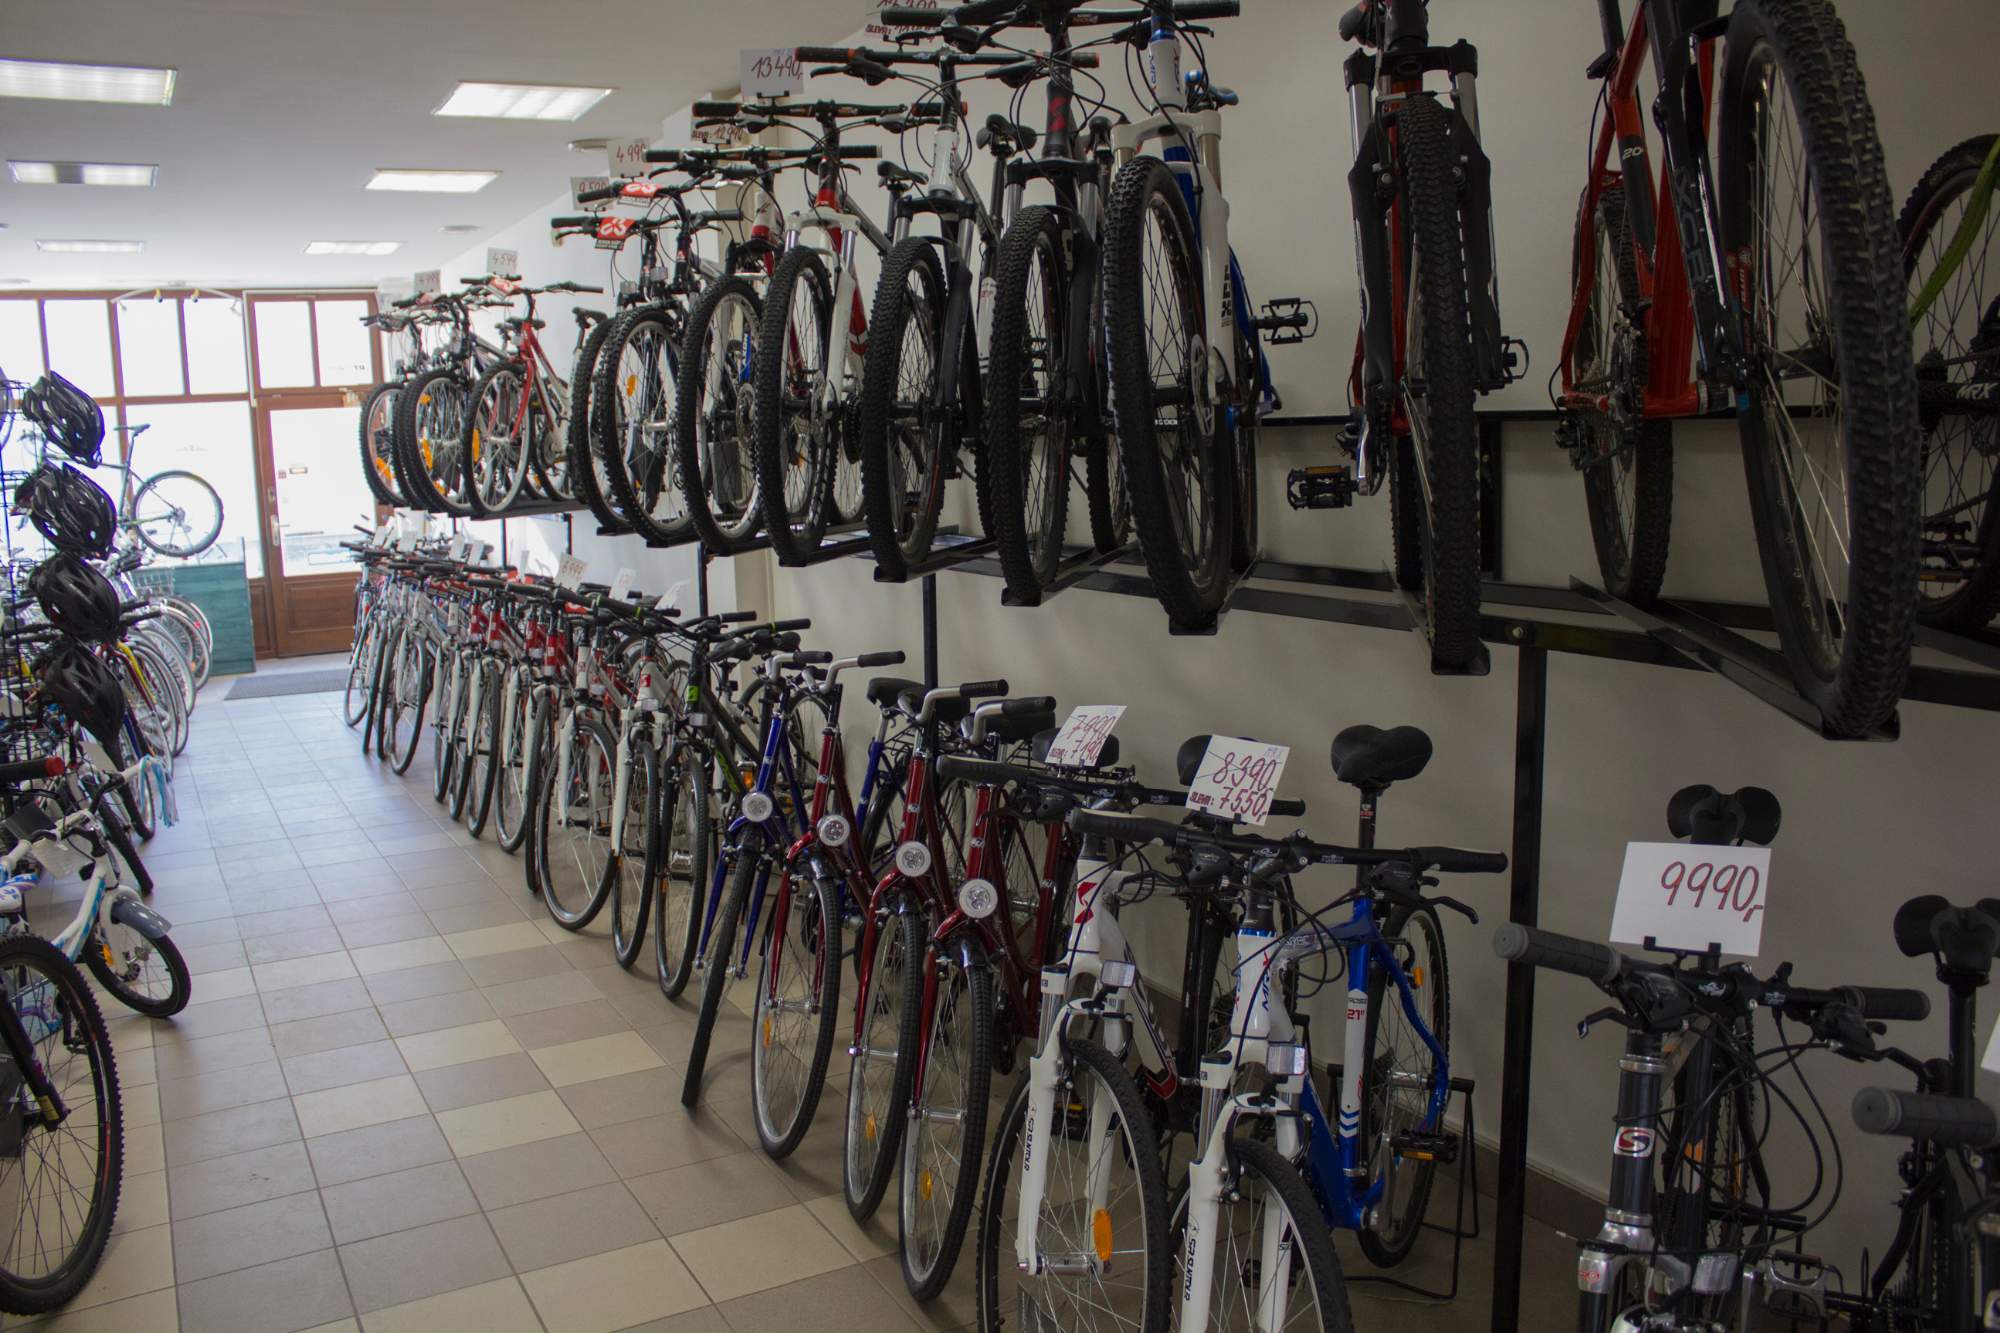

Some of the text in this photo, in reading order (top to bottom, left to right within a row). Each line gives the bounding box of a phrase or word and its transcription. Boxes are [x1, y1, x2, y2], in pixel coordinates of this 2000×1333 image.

[1219, 786, 1268, 823] 7550,-
[1660, 860, 1764, 923] 9990,-
[1346, 1008, 1366, 1021] 21"
